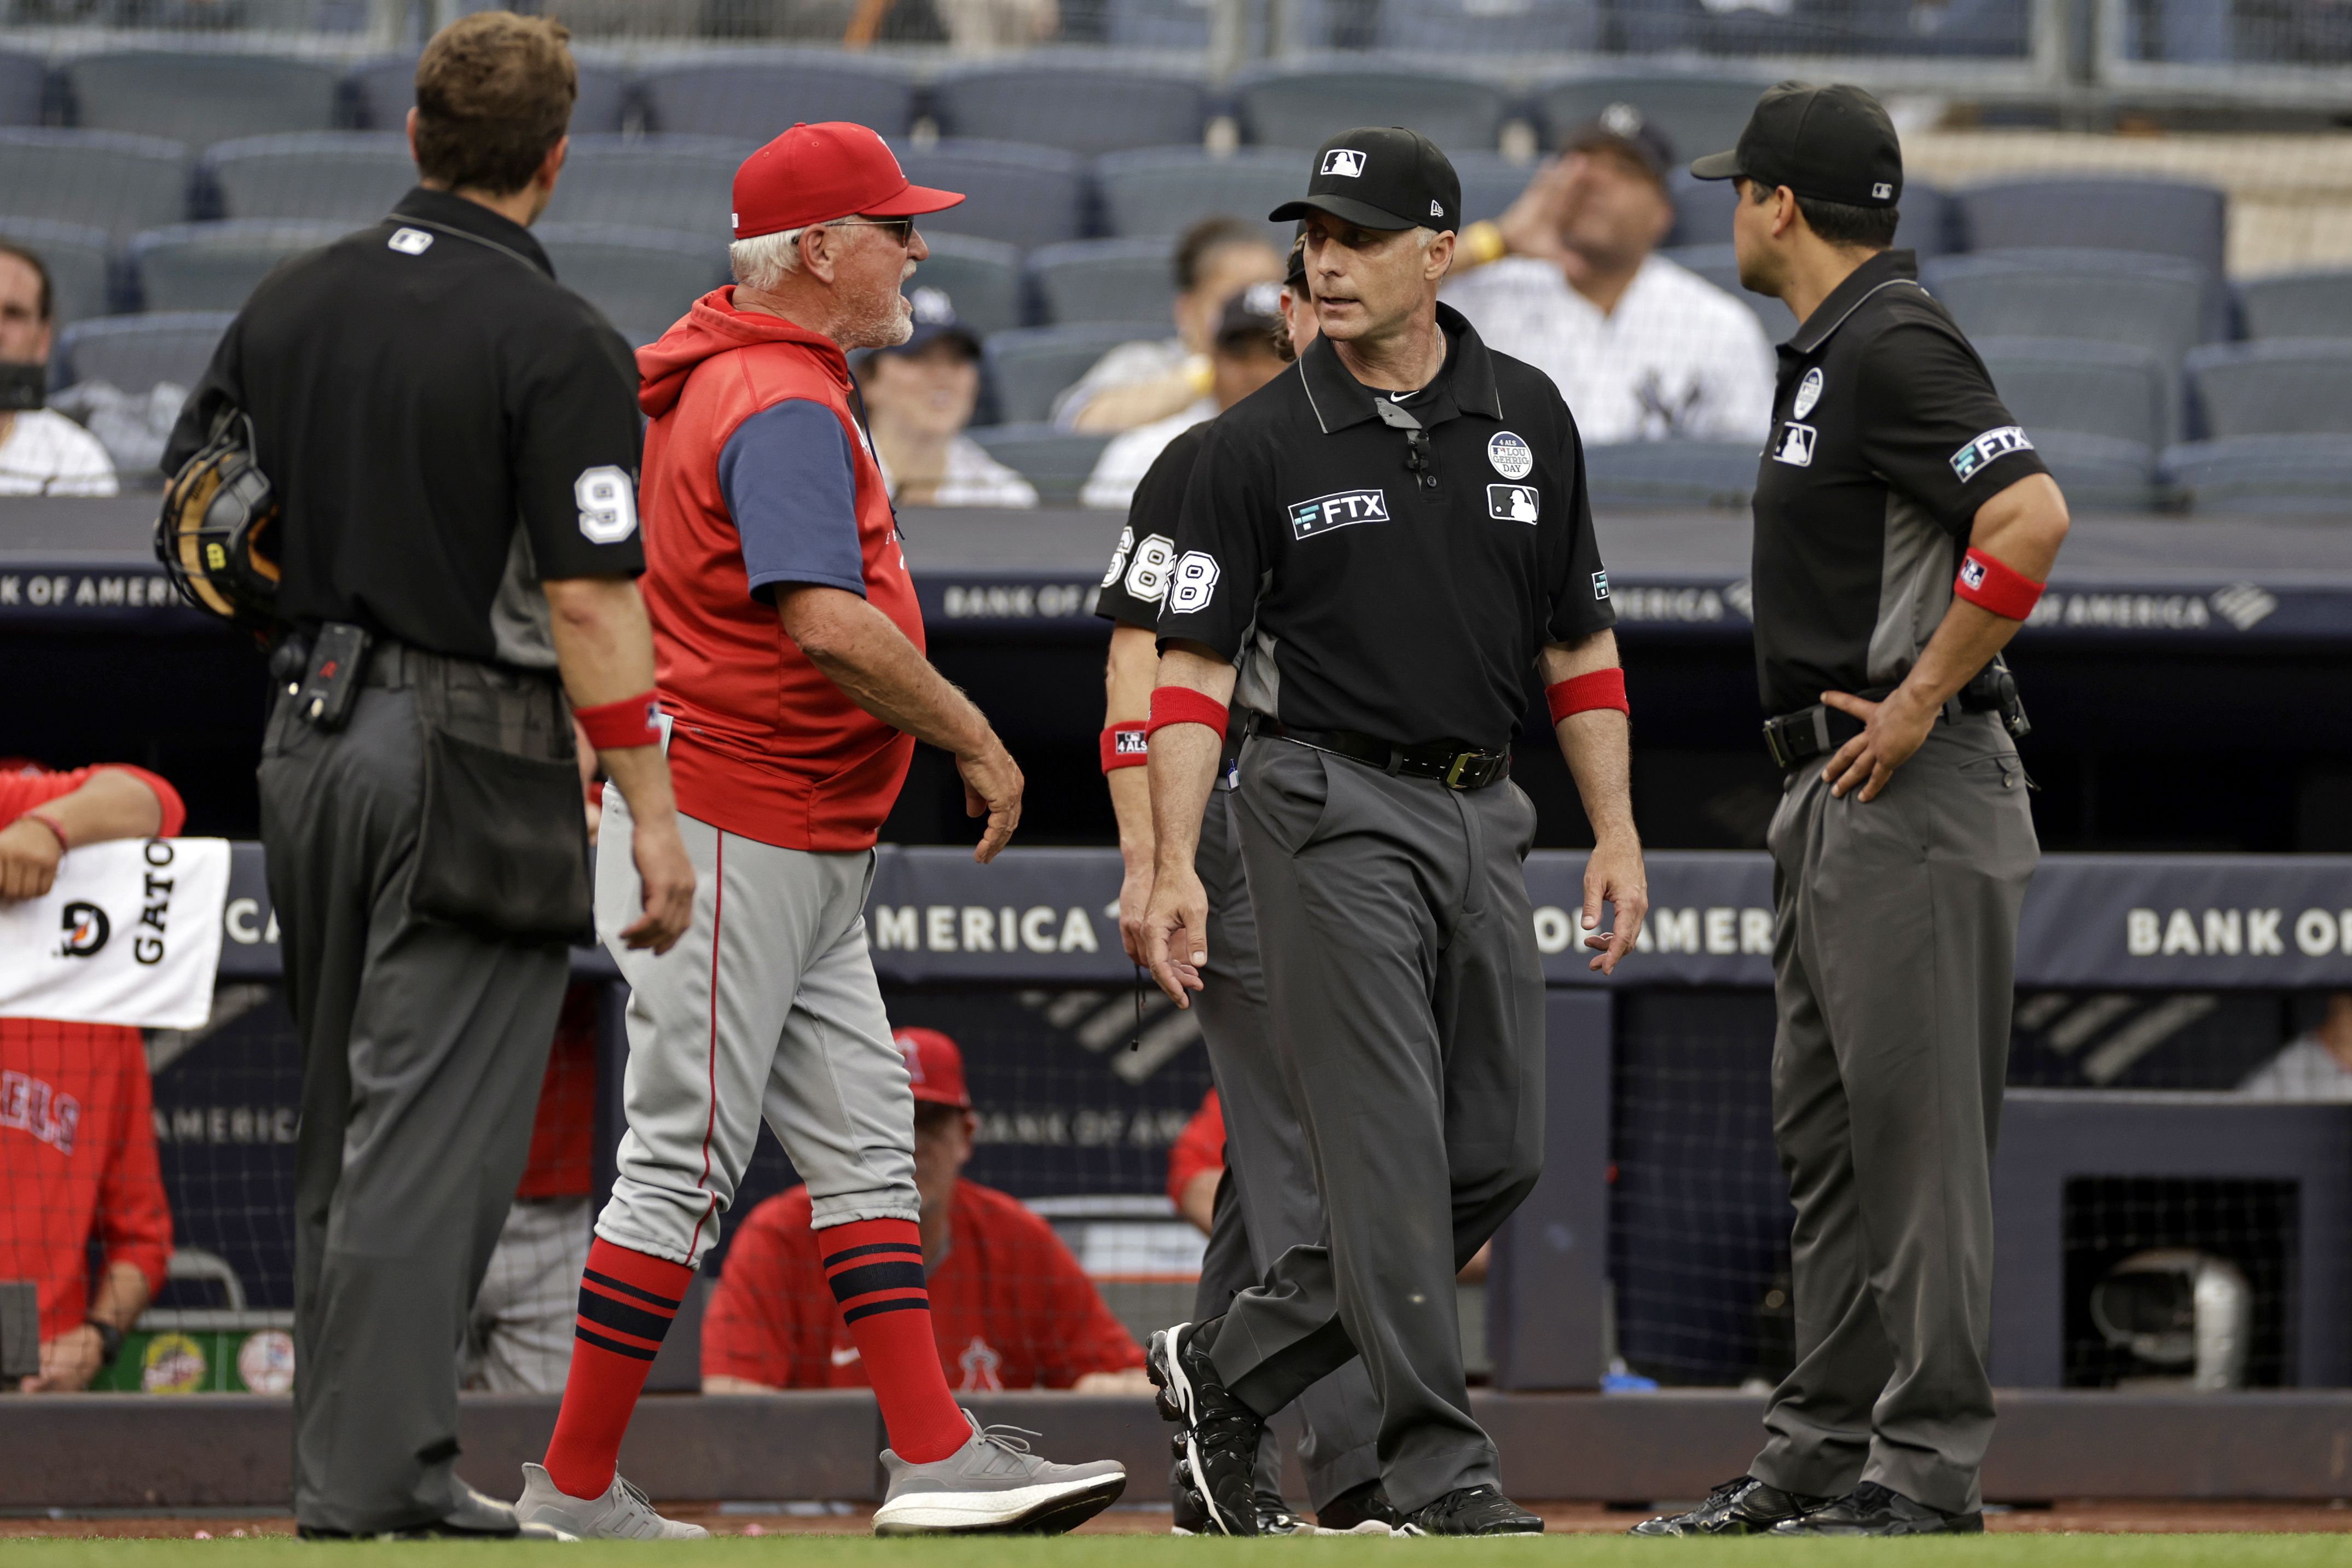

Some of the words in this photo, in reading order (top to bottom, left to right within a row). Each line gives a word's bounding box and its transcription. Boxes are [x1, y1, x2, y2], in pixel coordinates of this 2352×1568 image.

[1493, 455, 1529, 464] GEHRIG
[1506, 448, 1525, 456] LOU
[1975, 428, 2031, 461] FTX
[1503, 464, 1521, 472] DAY
[574, 464, 638, 545] 9
[1322, 495, 1384, 524] FTX
[27, 574, 71, 606] OF
[943, 585, 1036, 618] BANK
[1038, 584, 1084, 618] OF
[2065, 594, 2209, 629] AMERICA
[1118, 741, 1125, 752] 4
[1126, 741, 1148, 752] ALS
[862, 905, 1099, 953] MERICA
[2127, 908, 2286, 956] BANK
[0, 1070, 80, 1155] ELS
